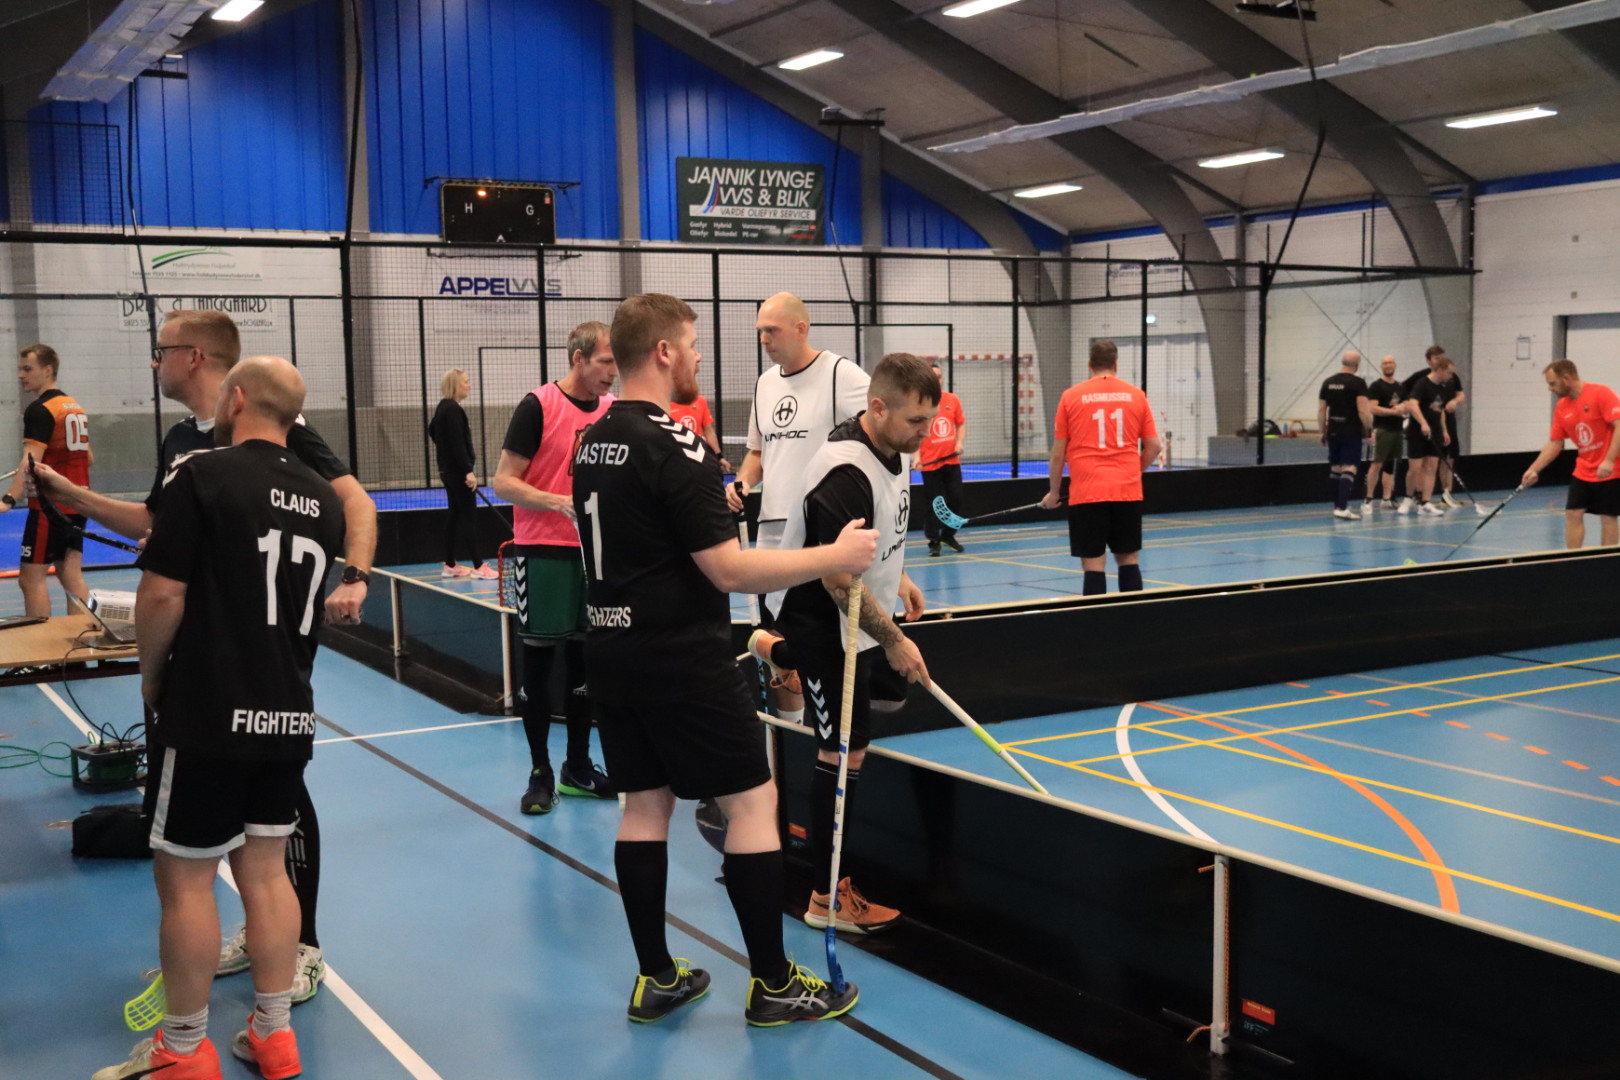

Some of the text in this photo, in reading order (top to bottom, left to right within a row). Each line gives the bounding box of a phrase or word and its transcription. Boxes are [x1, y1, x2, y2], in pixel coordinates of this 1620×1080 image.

[688, 166, 816, 189] JANNIK LYNGE
[464, 203, 473, 214] H
[719, 187, 811, 208] VVS & BLIK
[525, 204, 535, 216] G
[720, 207, 811, 219] VARDE OLIEFYR SERVICE
[1081, 392, 1132, 405] RASMUSSEN
[1092, 408, 1125, 449] 11
[270, 488, 321, 518] CLAUS
[584, 491, 604, 581] 1
[257, 528, 327, 636] 17
[231, 708, 315, 735] FIGHTERS
